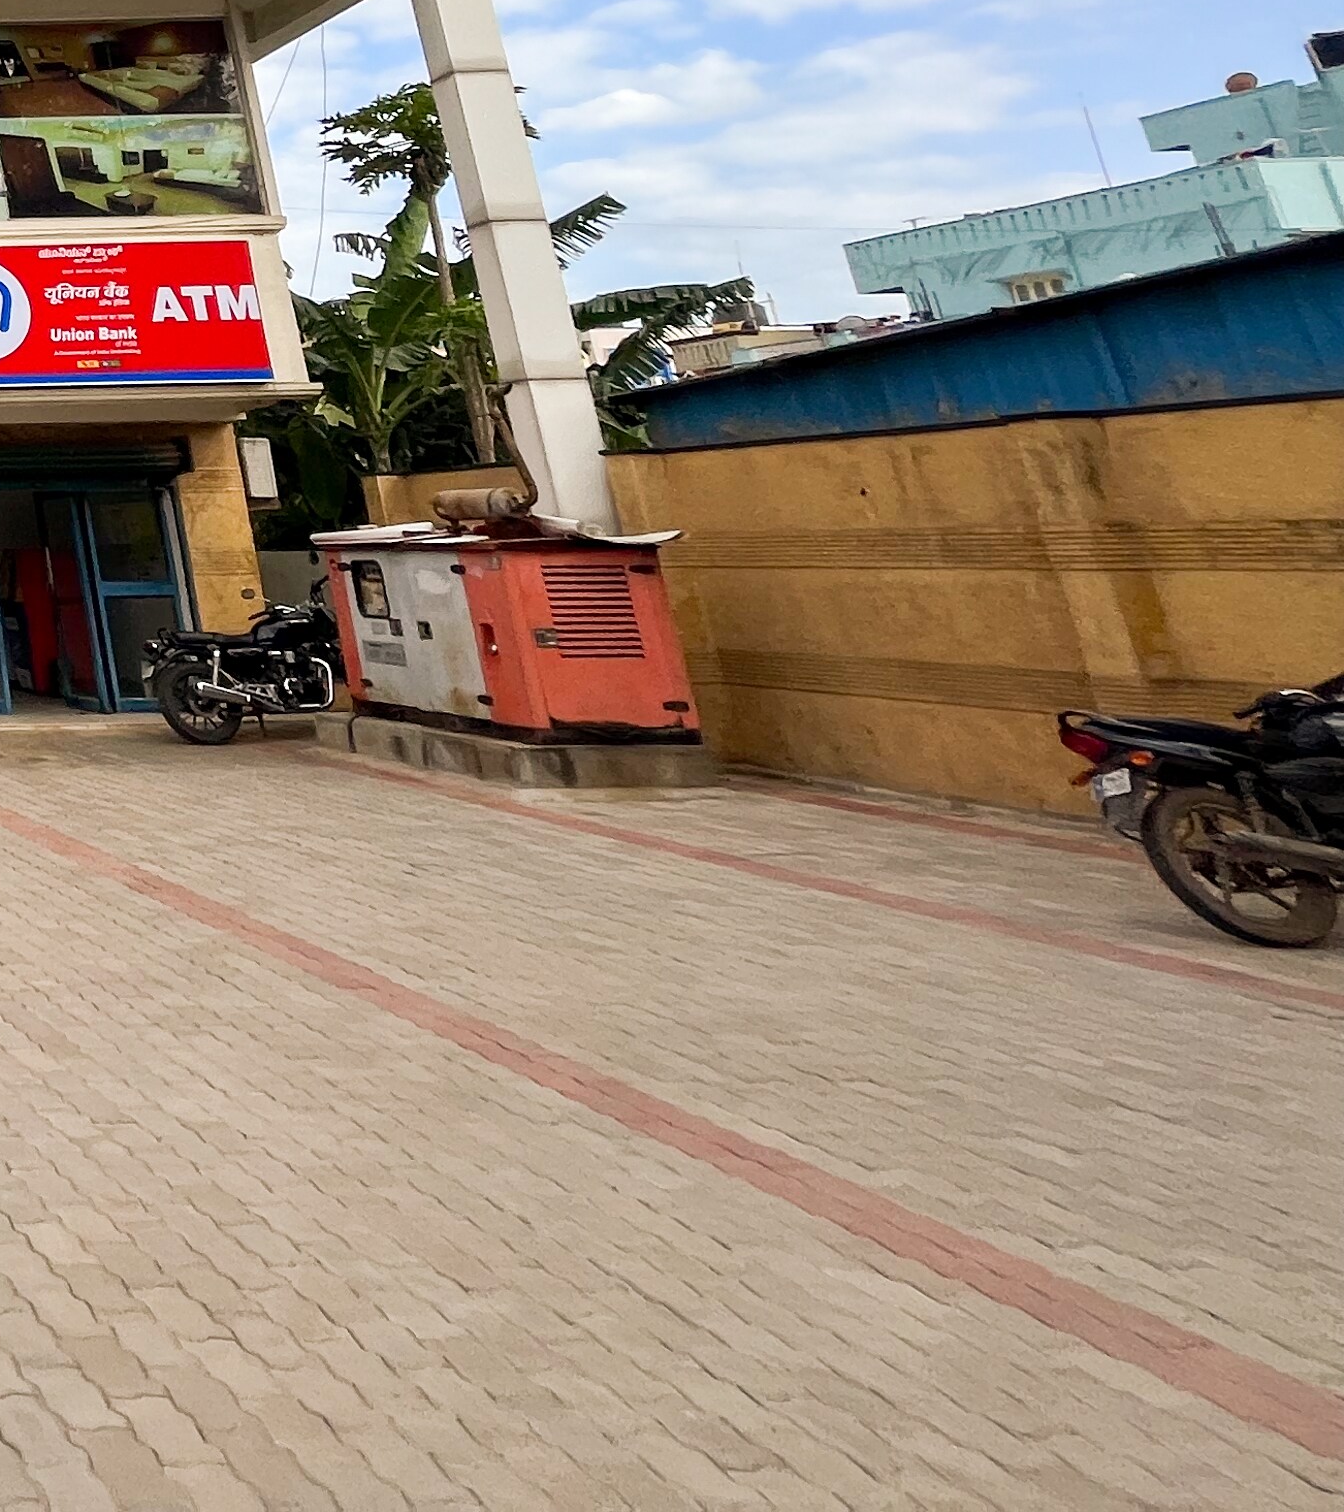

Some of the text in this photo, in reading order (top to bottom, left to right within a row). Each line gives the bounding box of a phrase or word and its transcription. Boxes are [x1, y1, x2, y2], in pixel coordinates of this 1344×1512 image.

[43, 282, 101, 305] यूनियन
[152, 284, 261, 322] ATM
[50, 326, 138, 342] Union Bank
